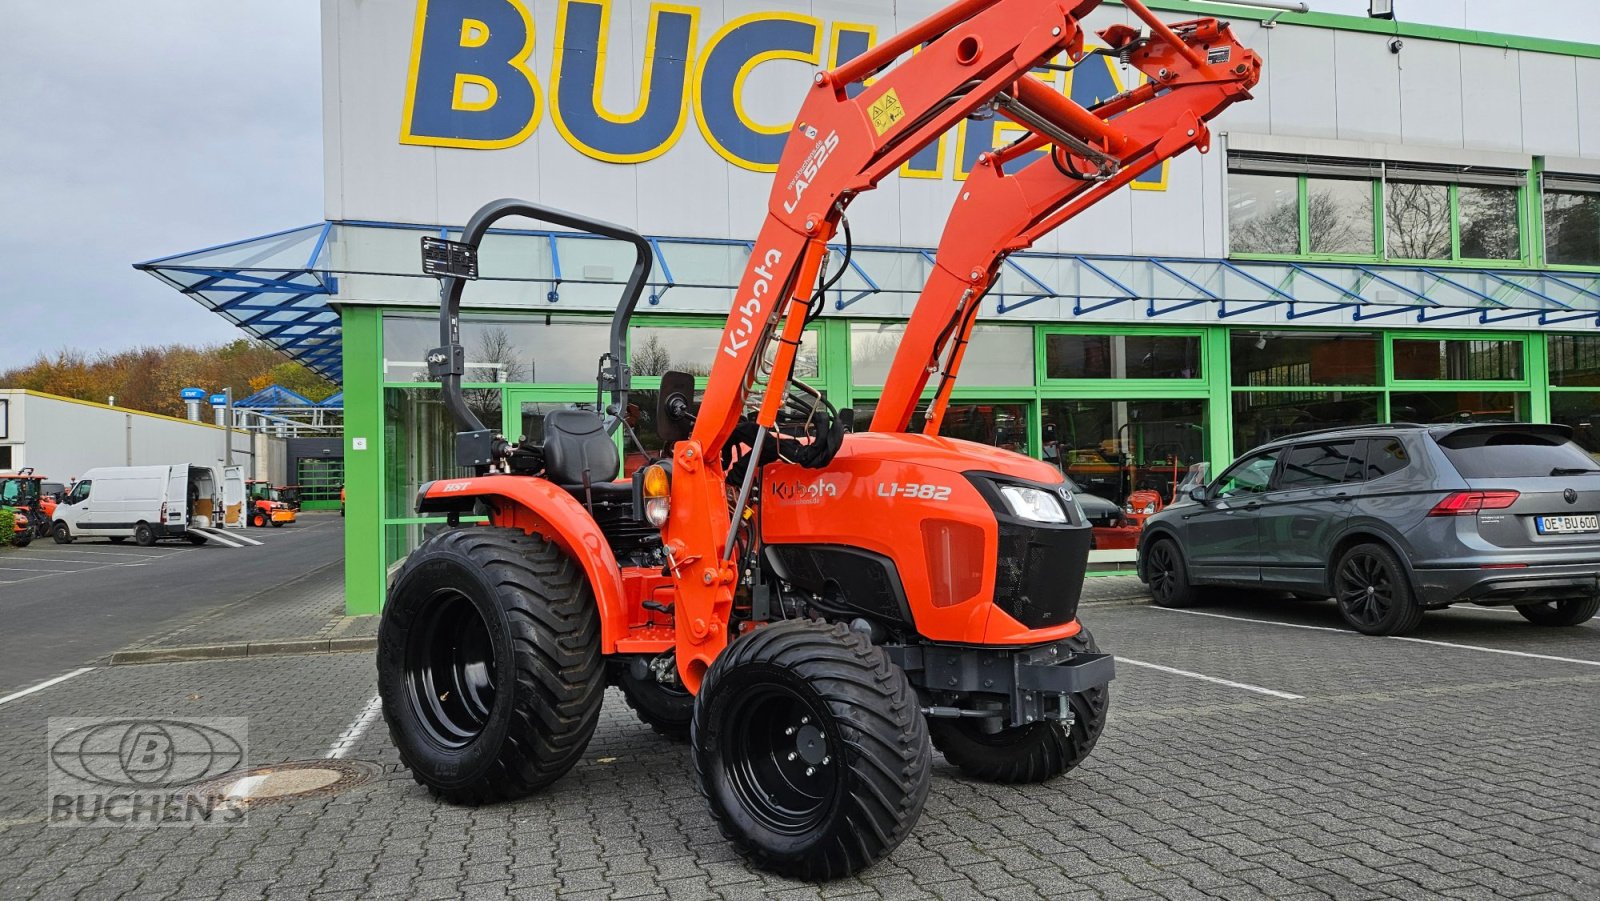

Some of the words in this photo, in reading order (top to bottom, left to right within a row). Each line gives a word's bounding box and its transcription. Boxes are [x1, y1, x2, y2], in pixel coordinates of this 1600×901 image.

[400, 0, 1168, 191] BUC
[783, 129, 840, 214] LA525
[723, 248, 783, 358] Kubota
[442, 482, 472, 492] HST
[772, 478, 837, 500] Kubota
[877, 482, 952, 501] L1-382
[1544, 518, 1558, 530] OE
